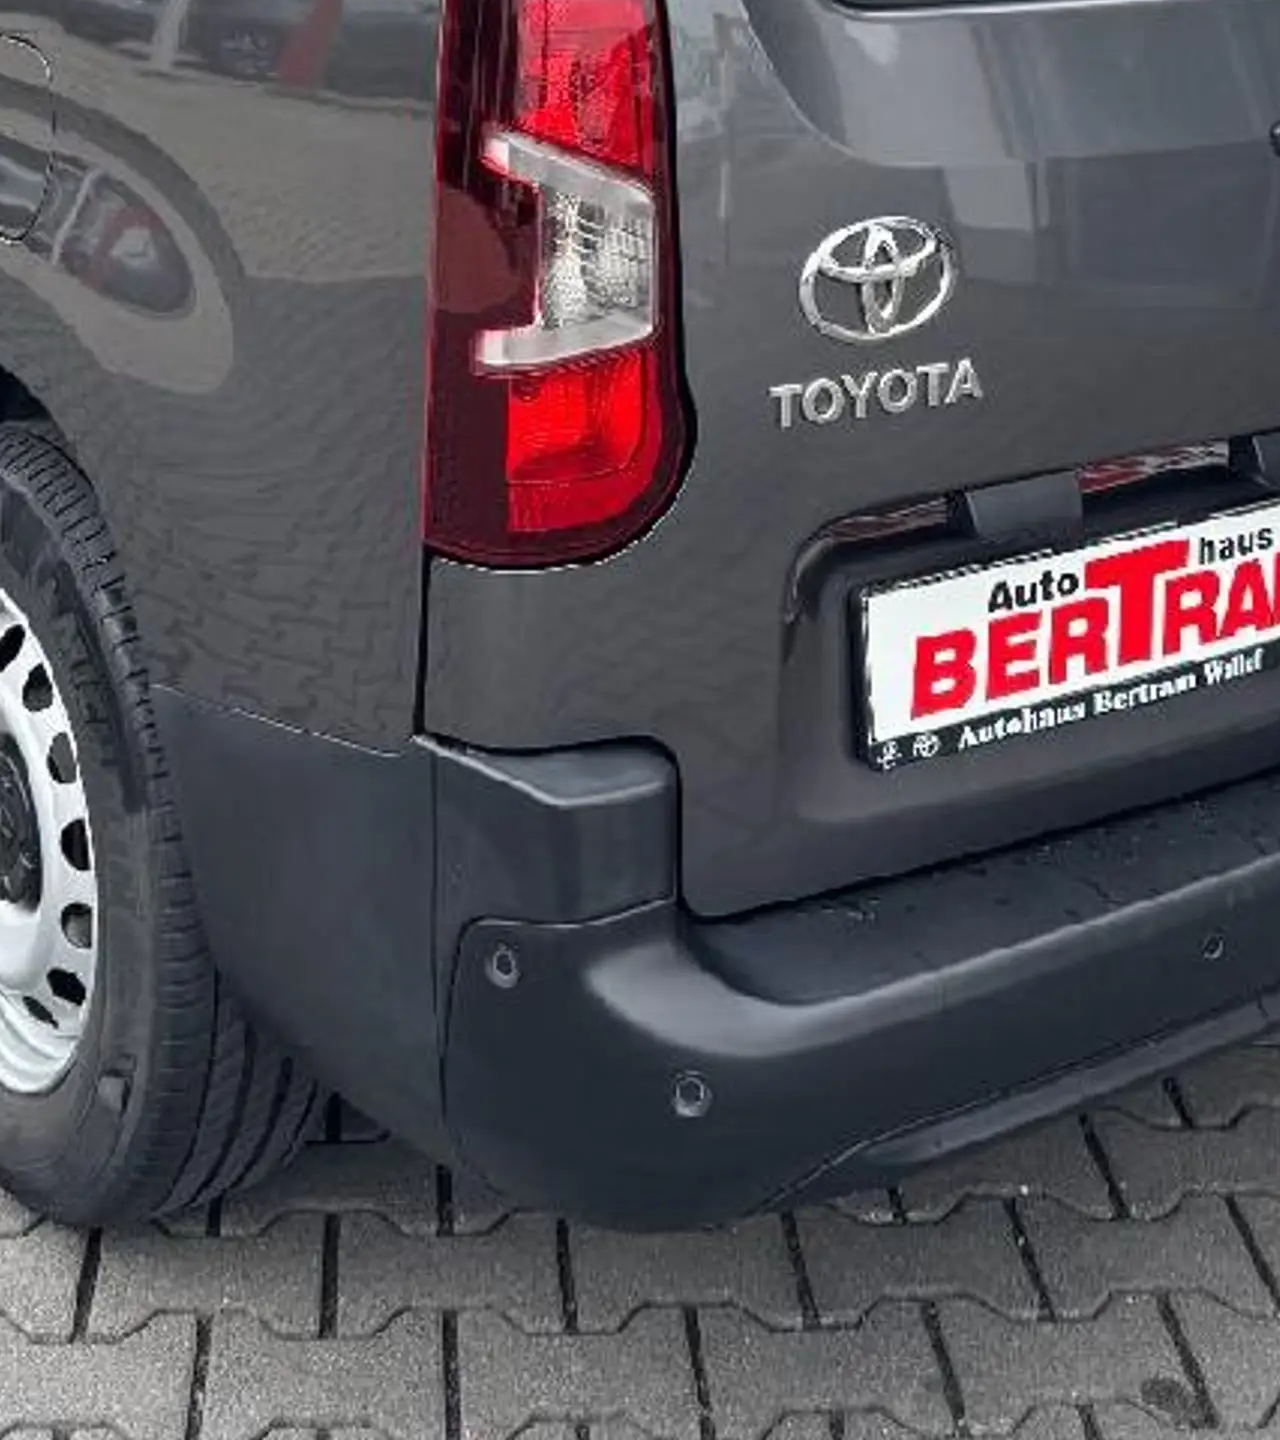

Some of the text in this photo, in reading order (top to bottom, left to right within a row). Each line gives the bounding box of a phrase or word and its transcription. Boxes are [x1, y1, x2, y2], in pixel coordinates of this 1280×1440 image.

[768, 357, 984, 430] TOYOTA
[988, 527, 1274, 613] Auto haus
[957, 700, 1087, 751] Autohaus
[1093, 671, 1198, 716] Bertram
